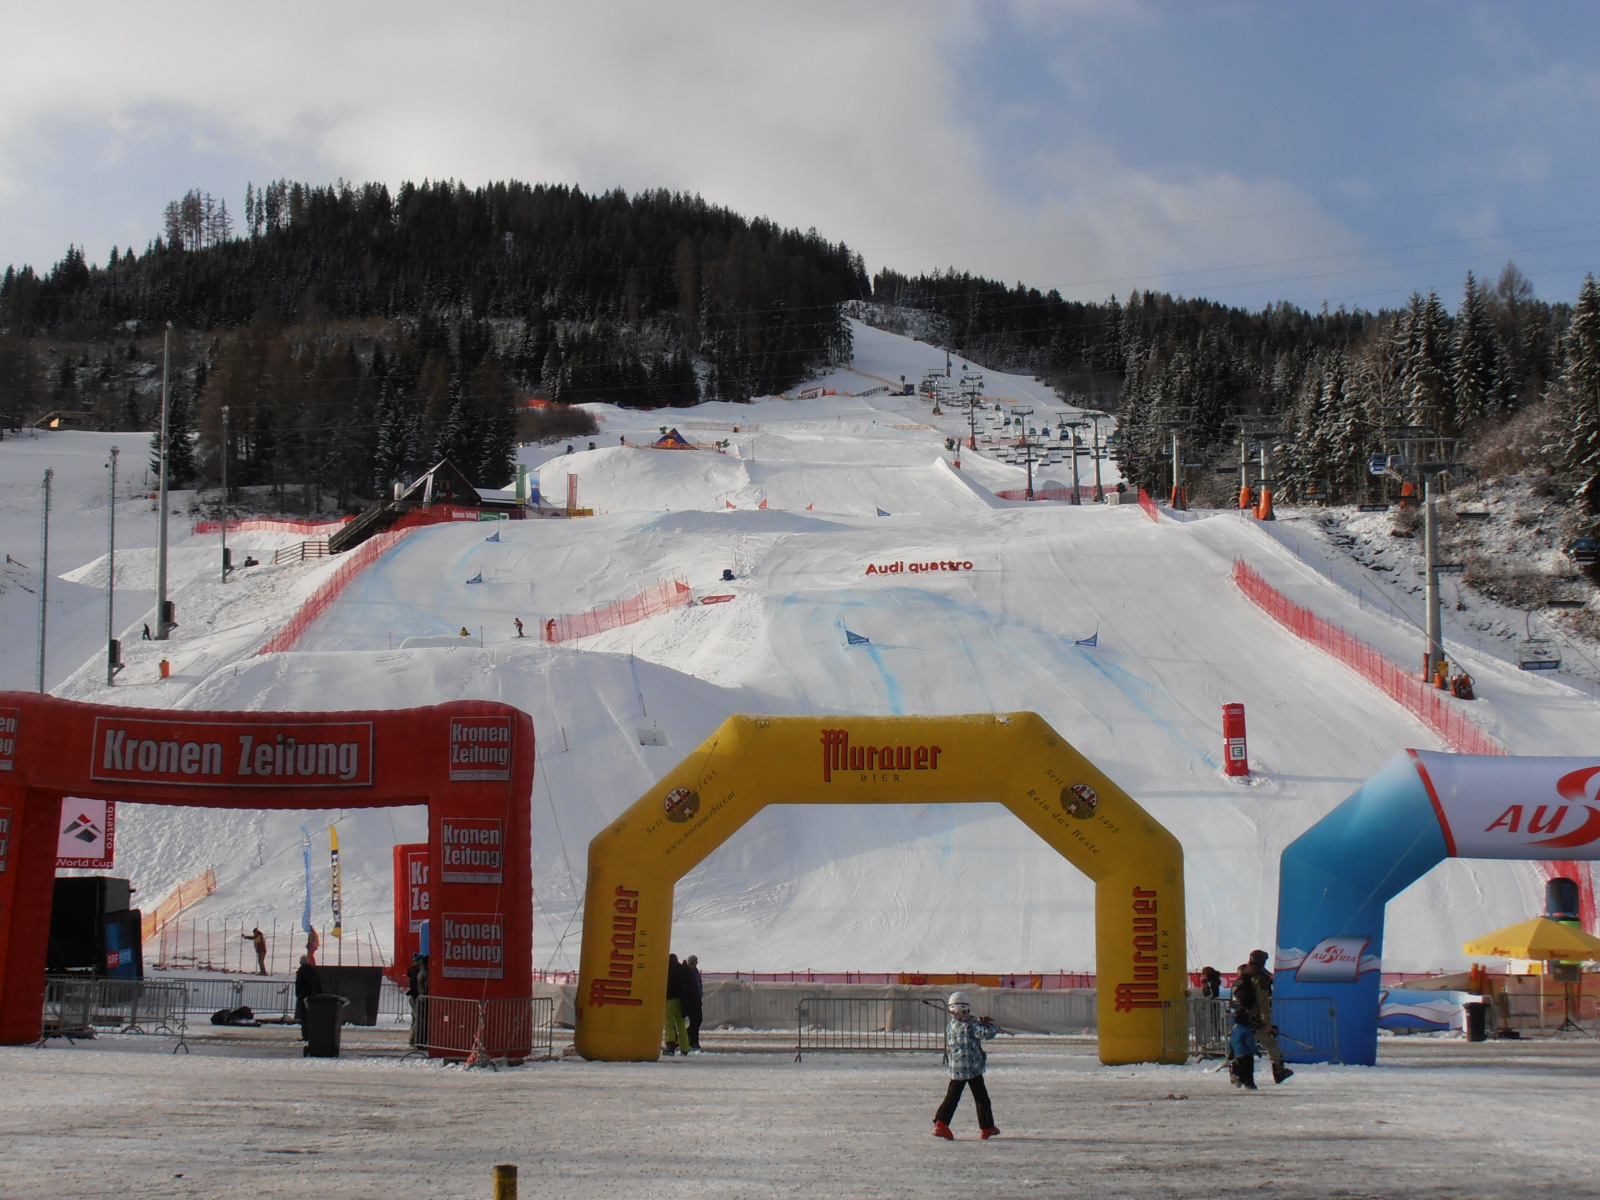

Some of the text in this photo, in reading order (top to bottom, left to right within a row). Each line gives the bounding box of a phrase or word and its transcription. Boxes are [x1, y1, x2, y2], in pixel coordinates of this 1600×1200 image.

[865, 560, 973, 575] Audi quattro
[452, 723, 509, 742] Kronen
[103, 729, 358, 780] Kronen Zeitung
[452, 743, 509, 765] Zeitung
[820, 729, 942, 782] Murauer
[860, 774, 901, 782] BIER
[1045, 768, 1120, 834] Seit 1495
[106, 806, 114, 849] quattro
[1026, 789, 1100, 854] Rein das Beste
[443, 824, 500, 844] Kronen
[92, 859, 113, 869] Cup
[443, 845, 500, 868] Zeitung
[444, 919, 501, 939] Kronen
[444, 940, 501, 963] Zeitung
[589, 885, 642, 1008] Murauer
[637, 929, 647, 969] BIER
[1115, 886, 1171, 1013] Murauer
